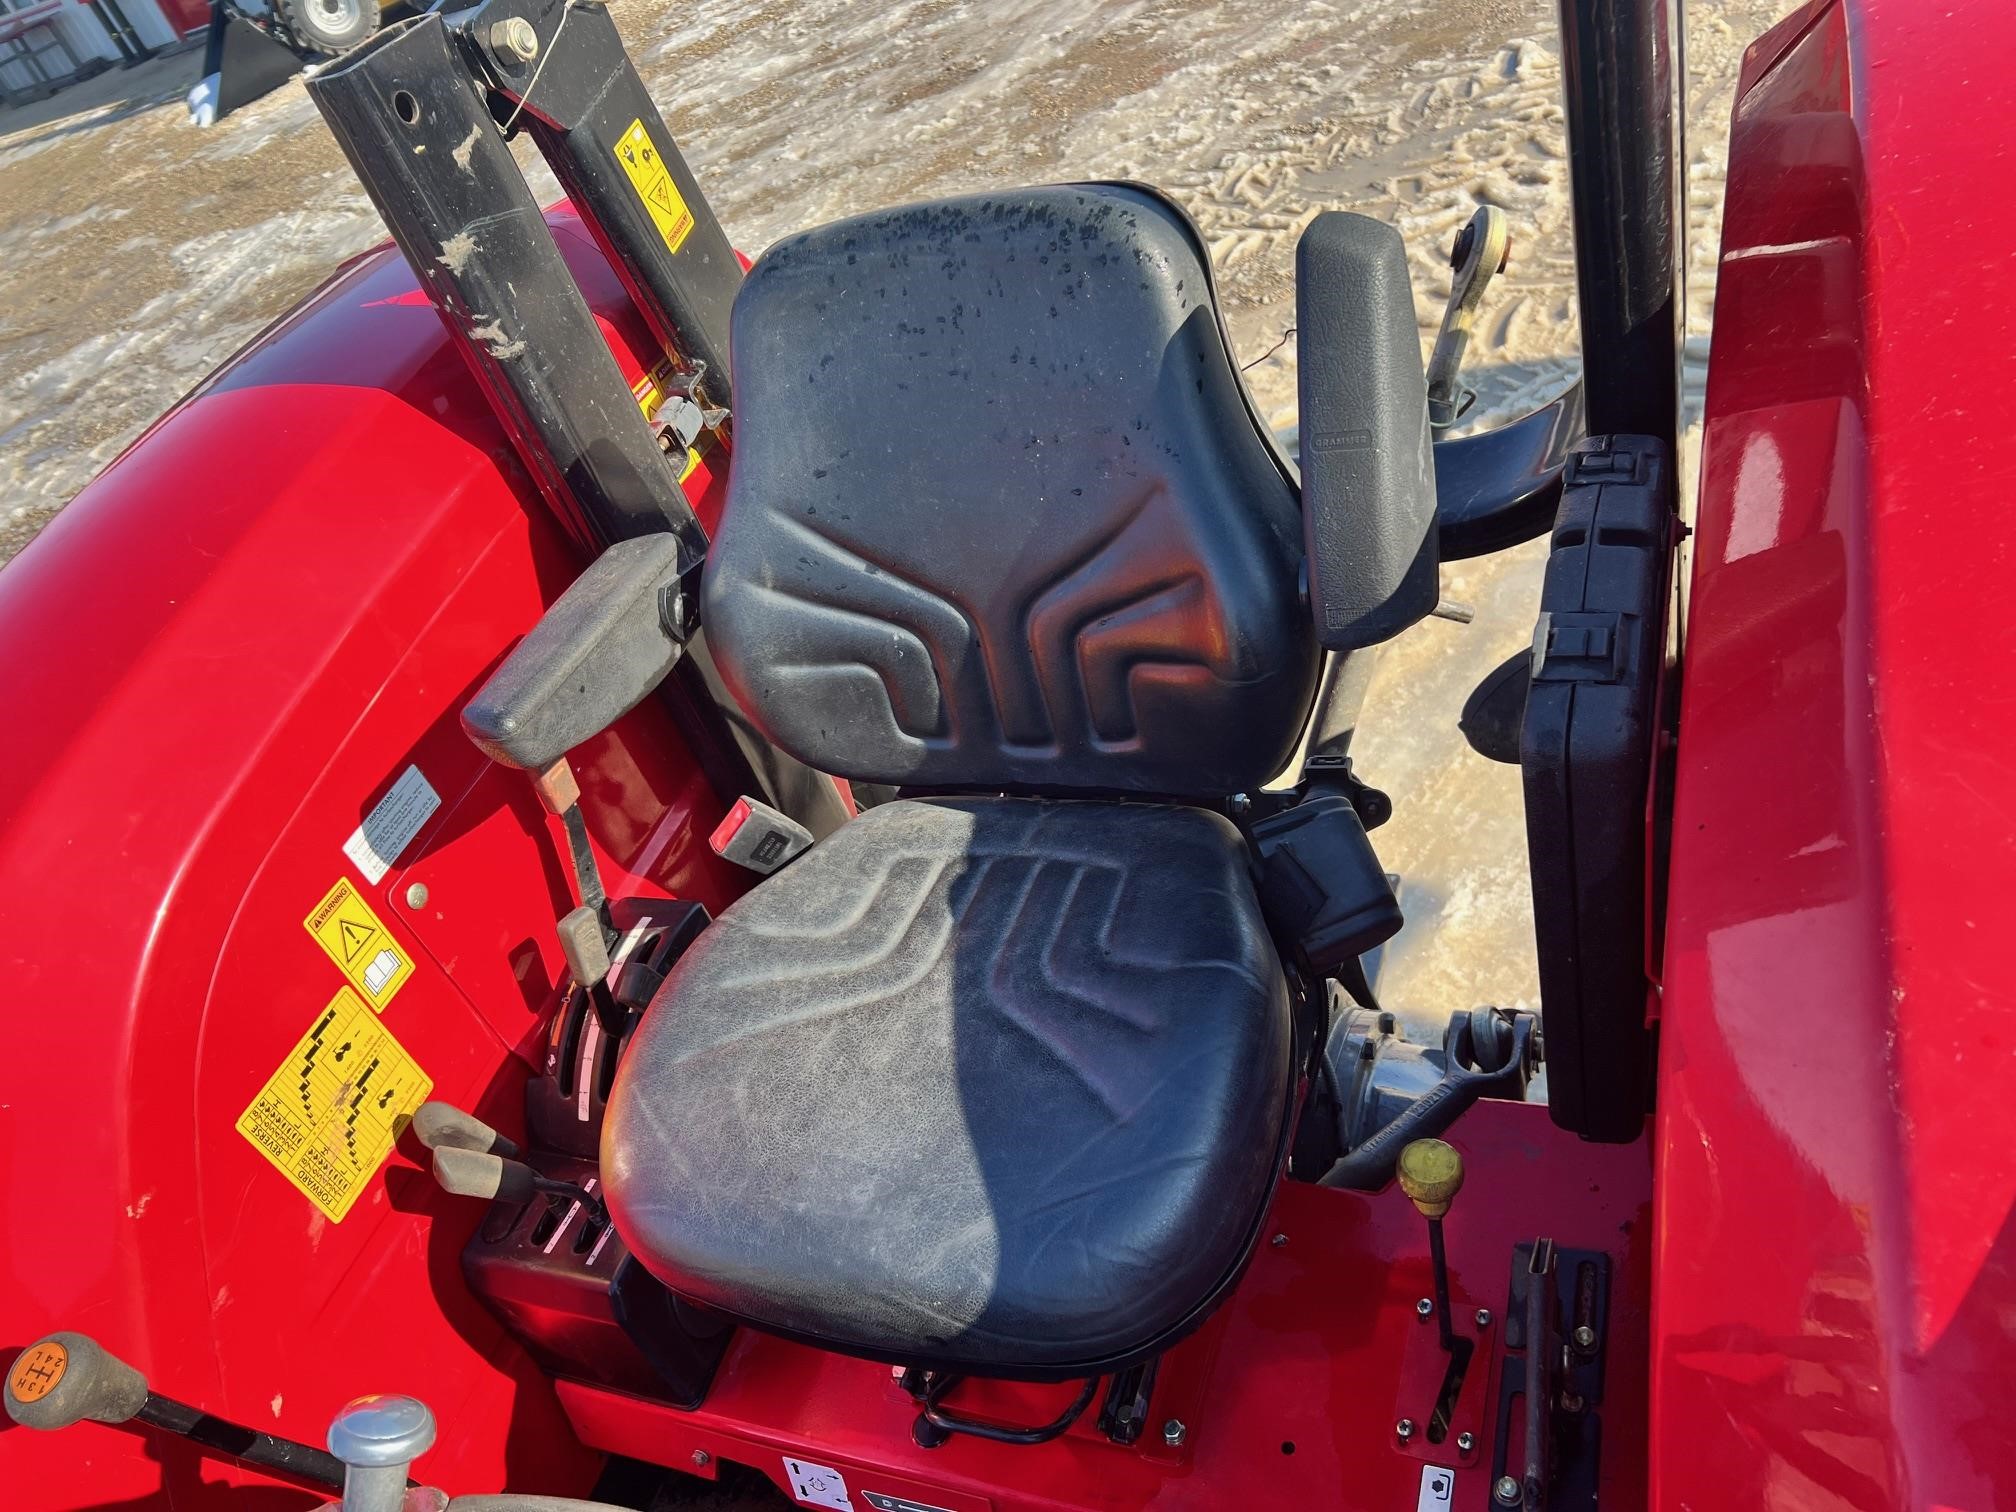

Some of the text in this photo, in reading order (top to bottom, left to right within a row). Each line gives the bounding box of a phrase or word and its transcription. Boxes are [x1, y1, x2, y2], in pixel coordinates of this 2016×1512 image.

[367, 791, 395, 825] IMPORTANT
[318, 887, 348, 920] WARNING
[251, 1124, 283, 1156] REVERSE
[298, 1170, 333, 1205] FORWARD
[36, 1351, 64, 1367] 2 4 L
[16, 1378, 45, 1394] 1 3 H
